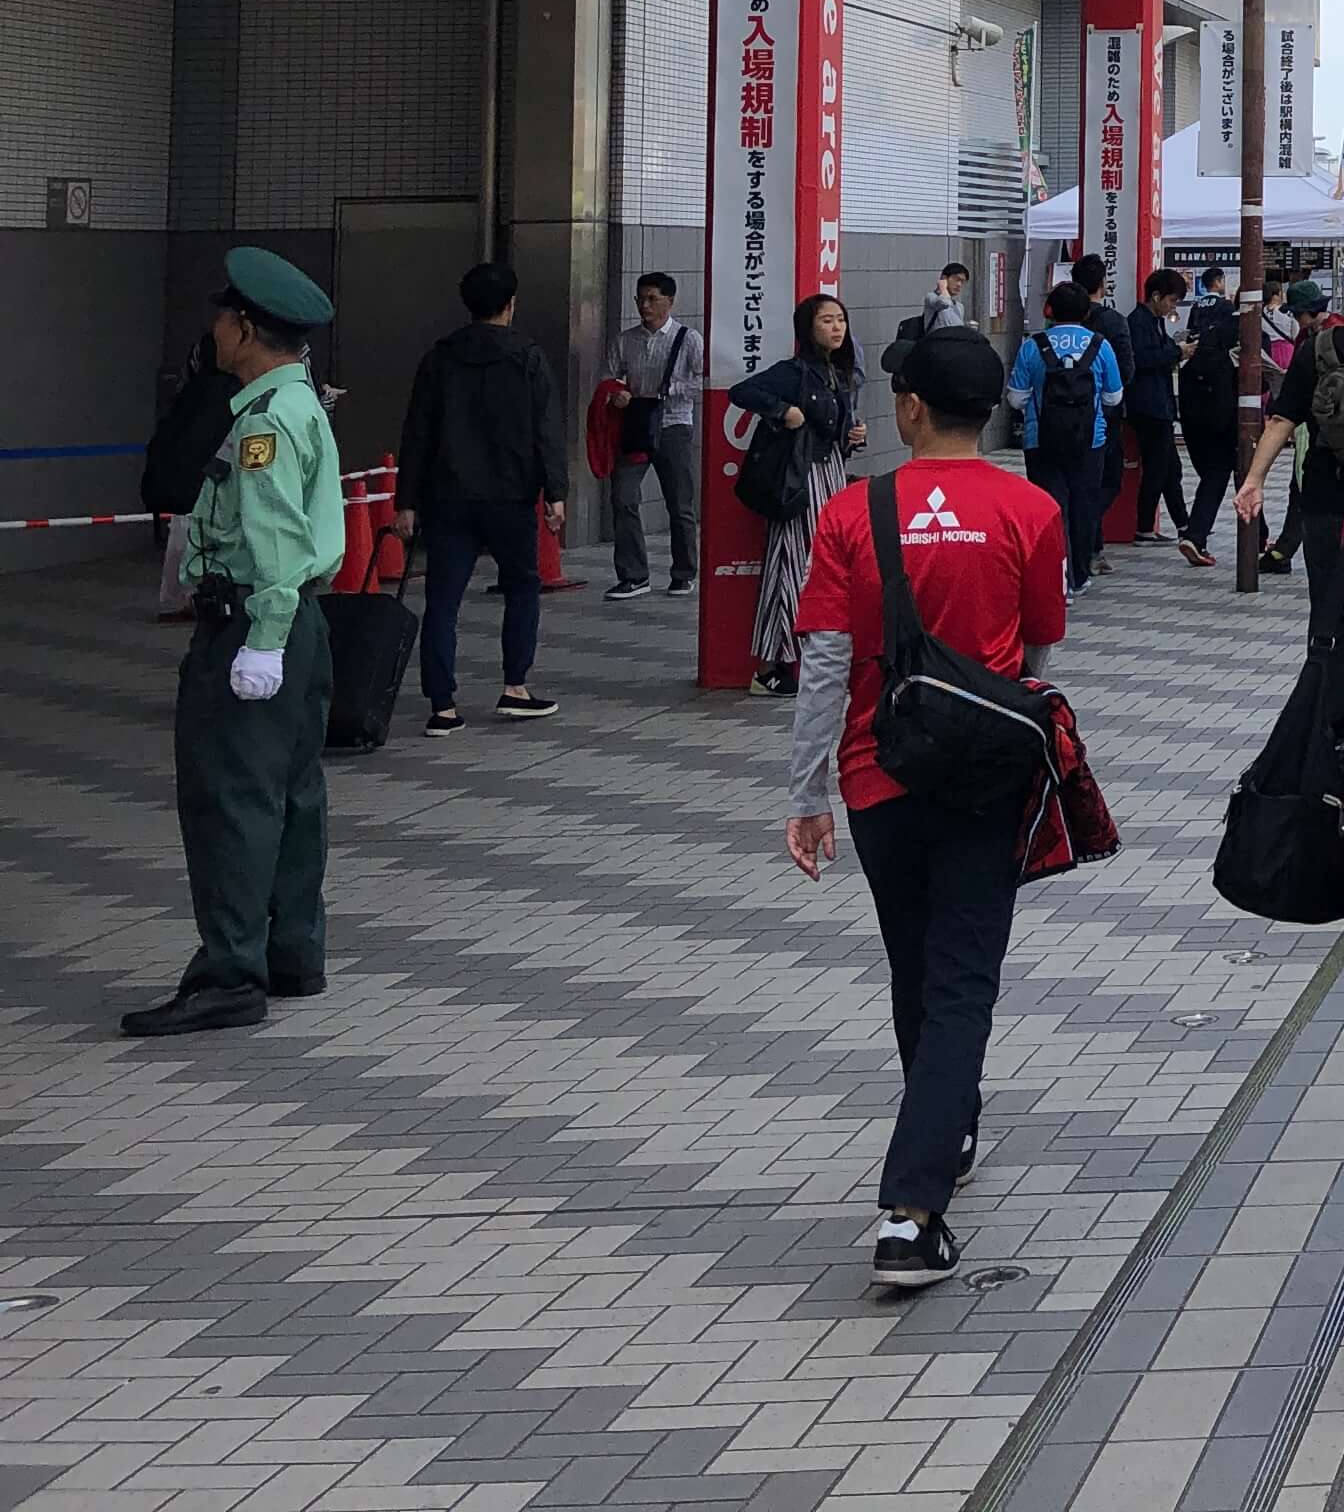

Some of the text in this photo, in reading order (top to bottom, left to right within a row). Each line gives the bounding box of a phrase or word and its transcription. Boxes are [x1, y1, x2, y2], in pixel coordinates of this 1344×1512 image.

[820, 59, 837, 190] are
[900, 530, 987, 545] UBISHI MOTORS
